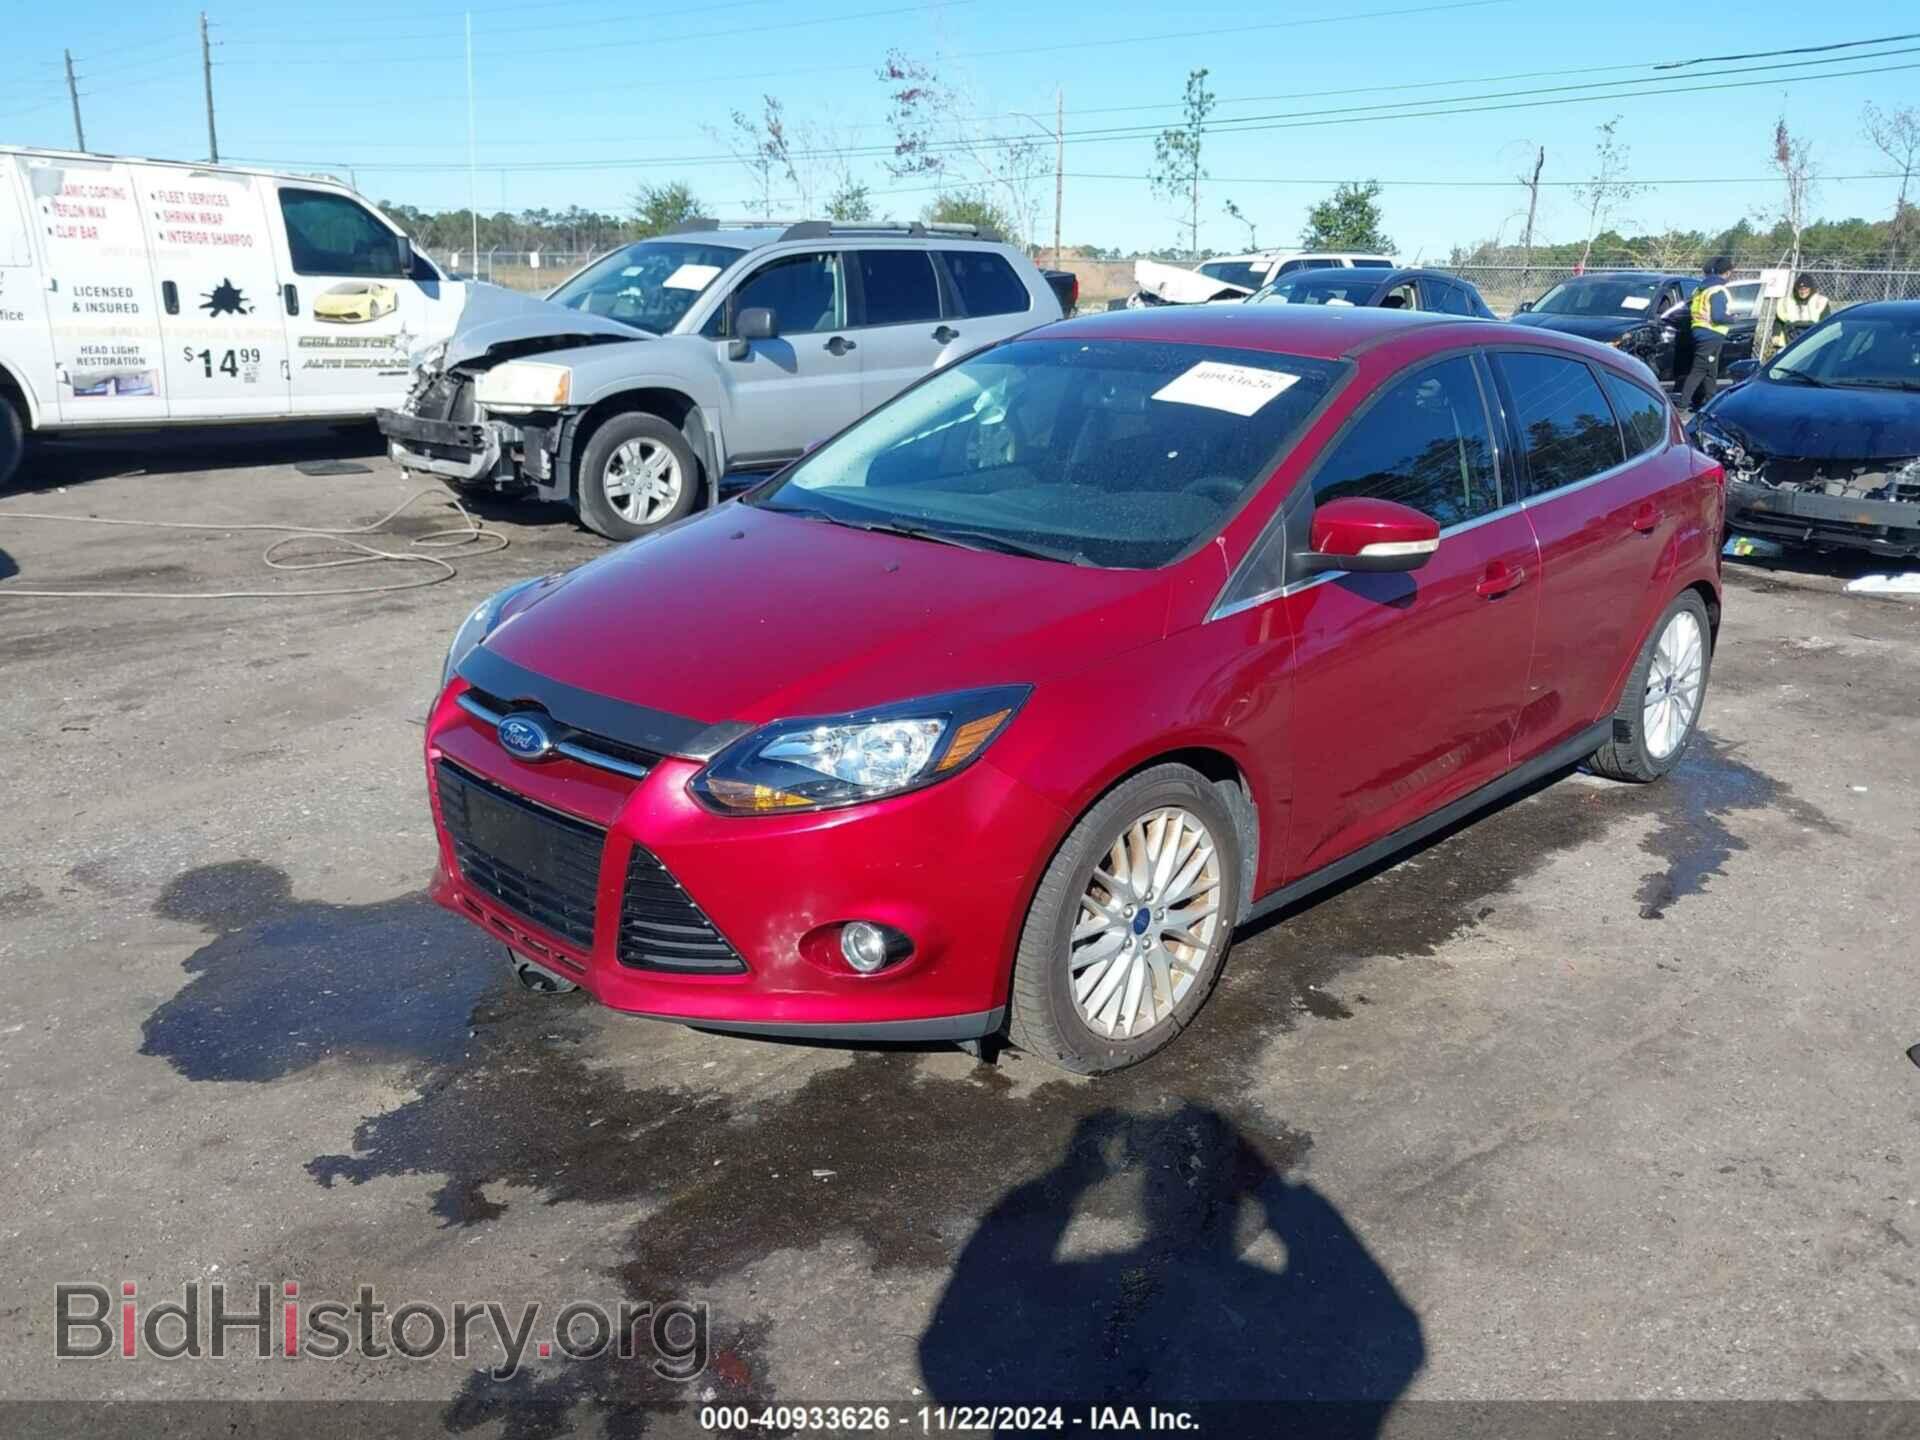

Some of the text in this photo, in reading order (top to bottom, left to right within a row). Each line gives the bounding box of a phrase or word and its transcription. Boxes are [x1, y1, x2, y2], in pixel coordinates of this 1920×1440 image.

[88, 185, 127, 200] COATING
[158, 190, 230, 207] FLEET SERVICES
[163, 210, 224, 225] SHRINK WRAP
[56, 224, 99, 240] CLAY BAR
[167, 230, 254, 247] INTERIOR SHAMPOO
[73, 286, 134, 298] LICENSED
[72, 302, 140, 314] & INSURED
[80, 345, 140, 355] HEAD LIGHT
[76, 356, 146, 366] RESTORATION
[303, 358, 342, 369] AUTO
[503, 722, 534, 749] Ford
